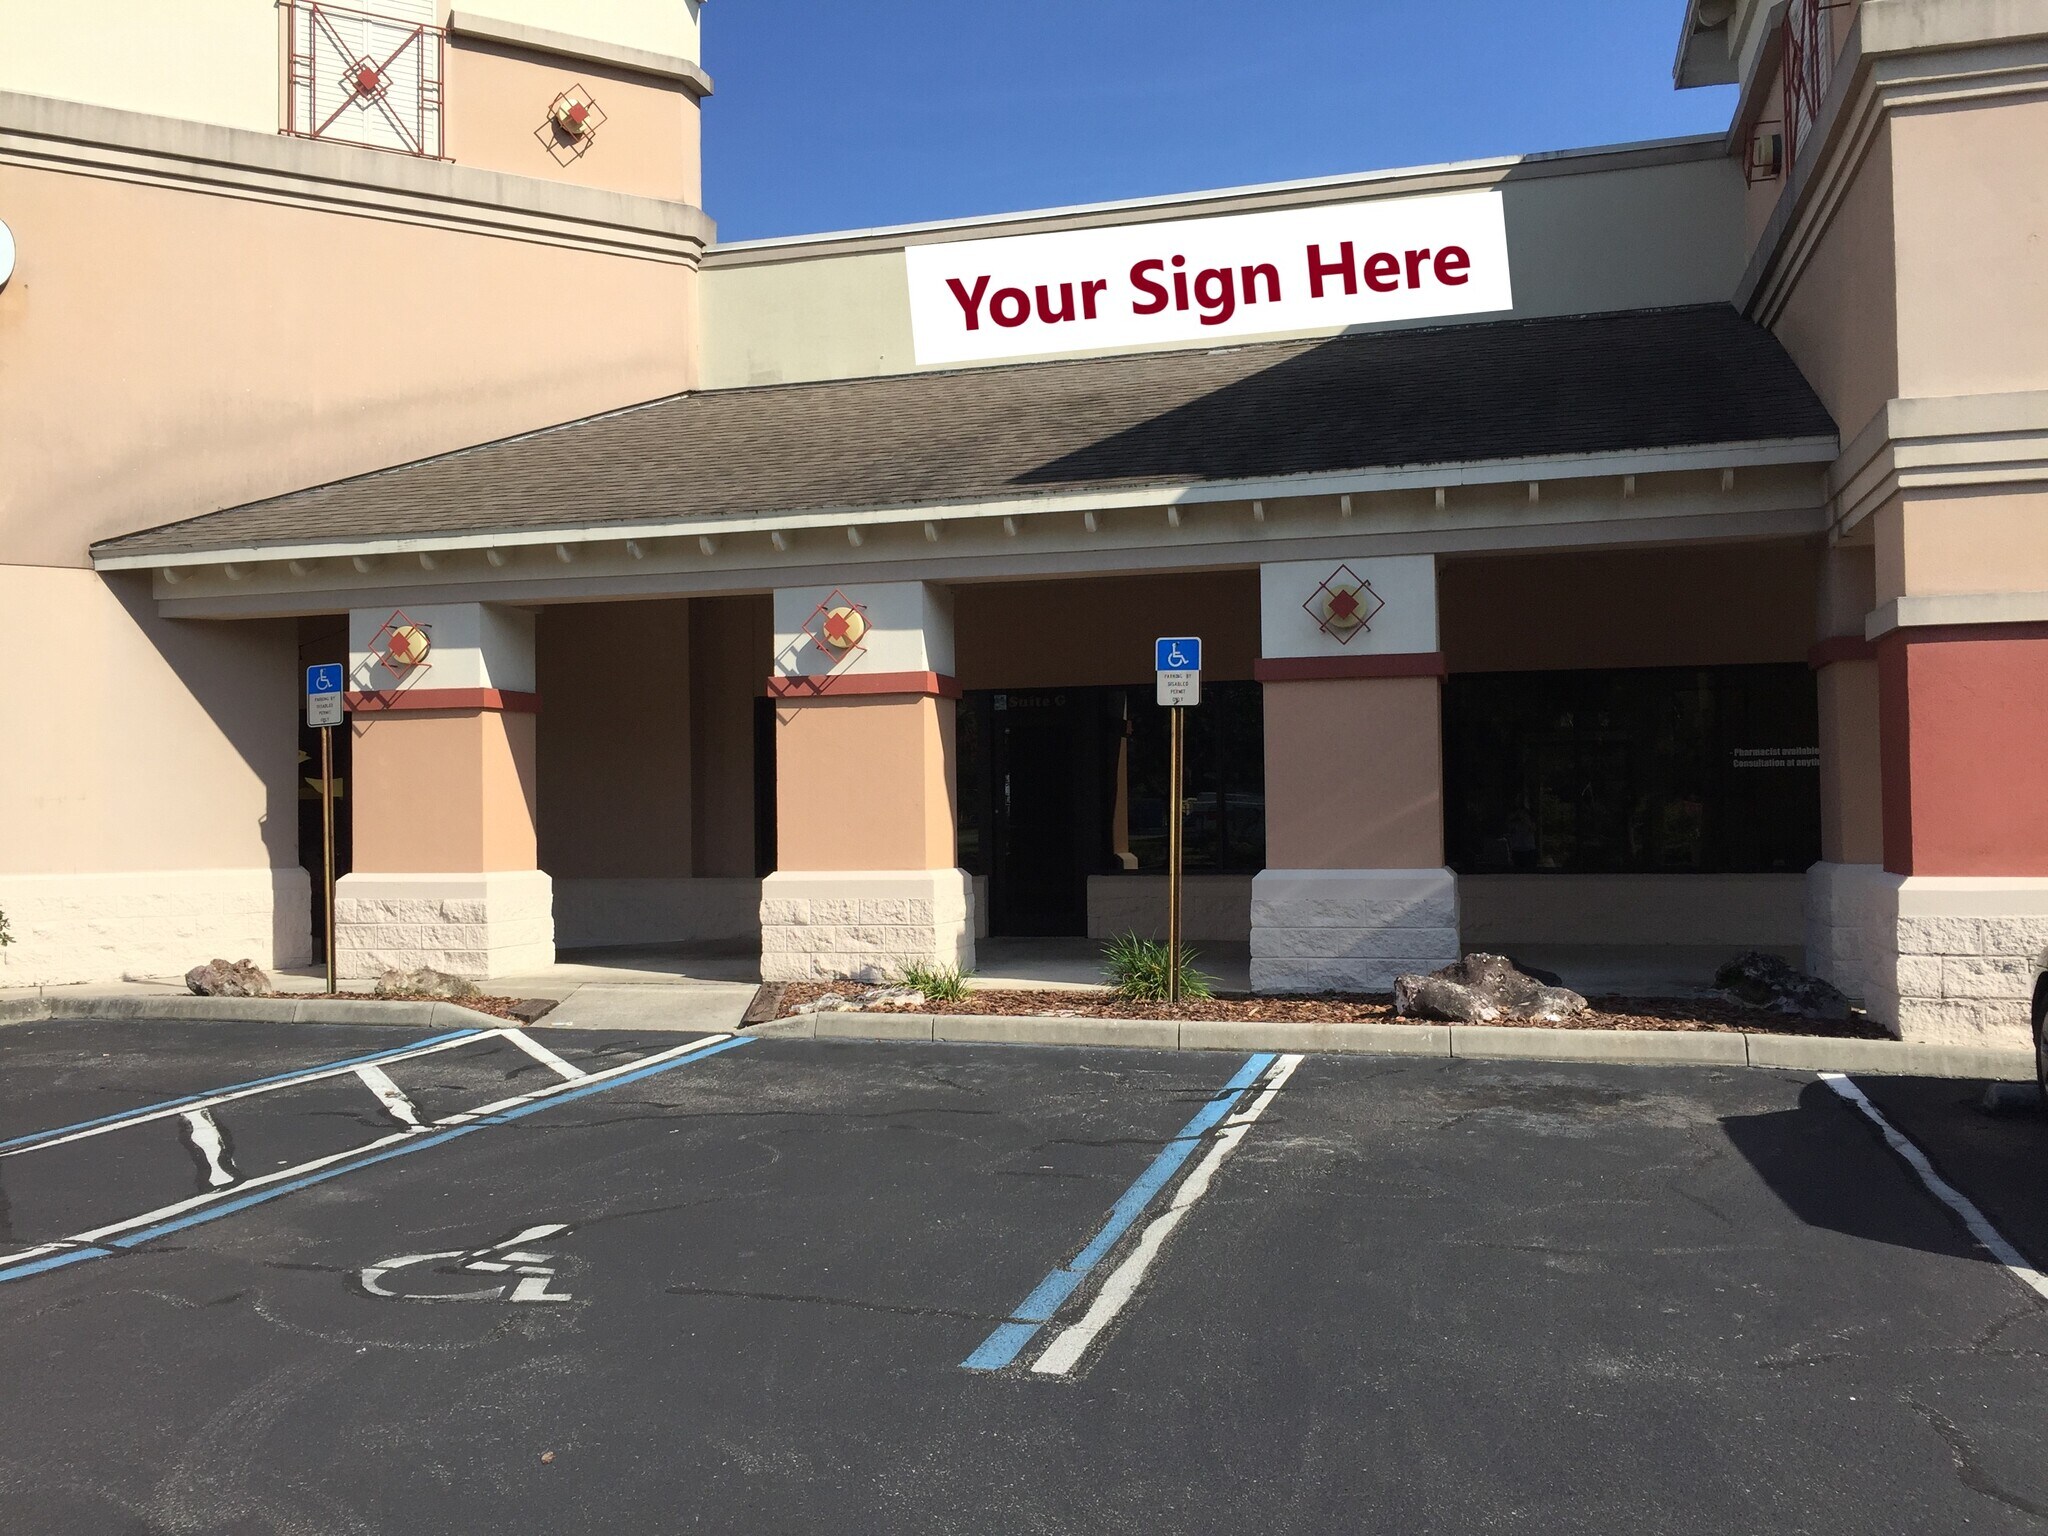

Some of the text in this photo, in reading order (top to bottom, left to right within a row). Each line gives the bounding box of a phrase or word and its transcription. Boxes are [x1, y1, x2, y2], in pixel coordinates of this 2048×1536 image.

[1734, 747, 1781, 757] Pharmacist
[1733, 758, 1785, 768] Consultation
[1786, 759, 1795, 767] at
